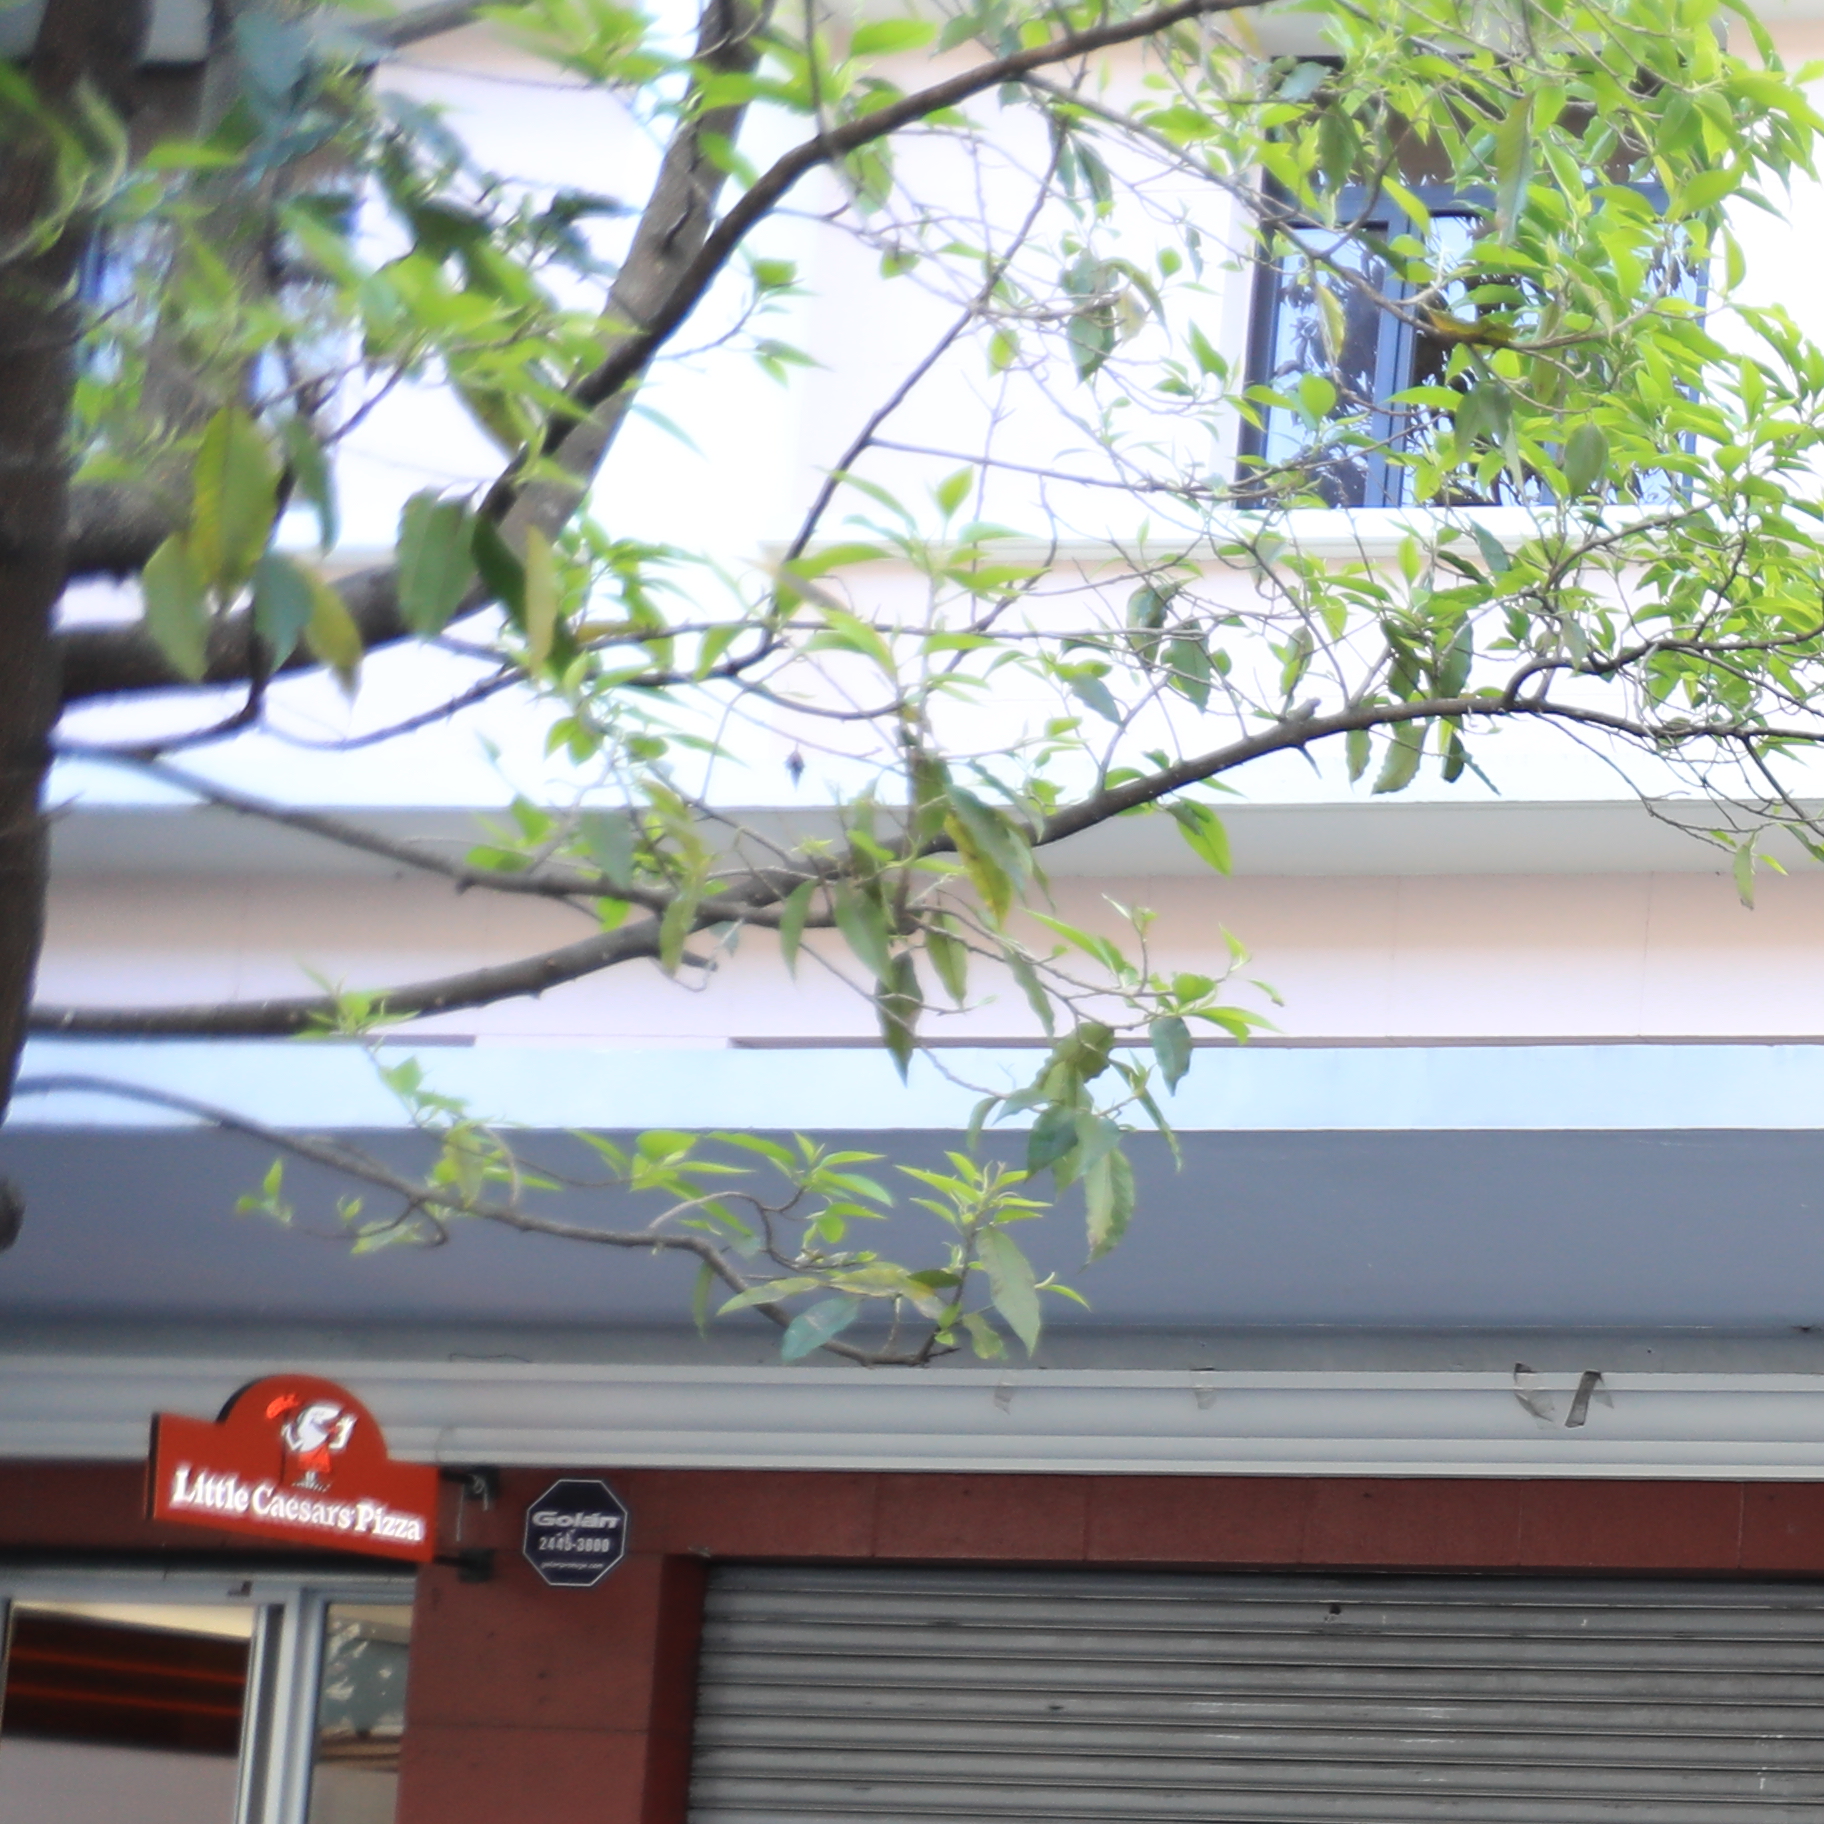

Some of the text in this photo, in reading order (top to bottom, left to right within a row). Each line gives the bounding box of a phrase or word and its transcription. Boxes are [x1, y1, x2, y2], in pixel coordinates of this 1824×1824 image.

[170, 1466, 425, 1541] Little Caesars Pizza
[532, 1511, 619, 1529] Golán
